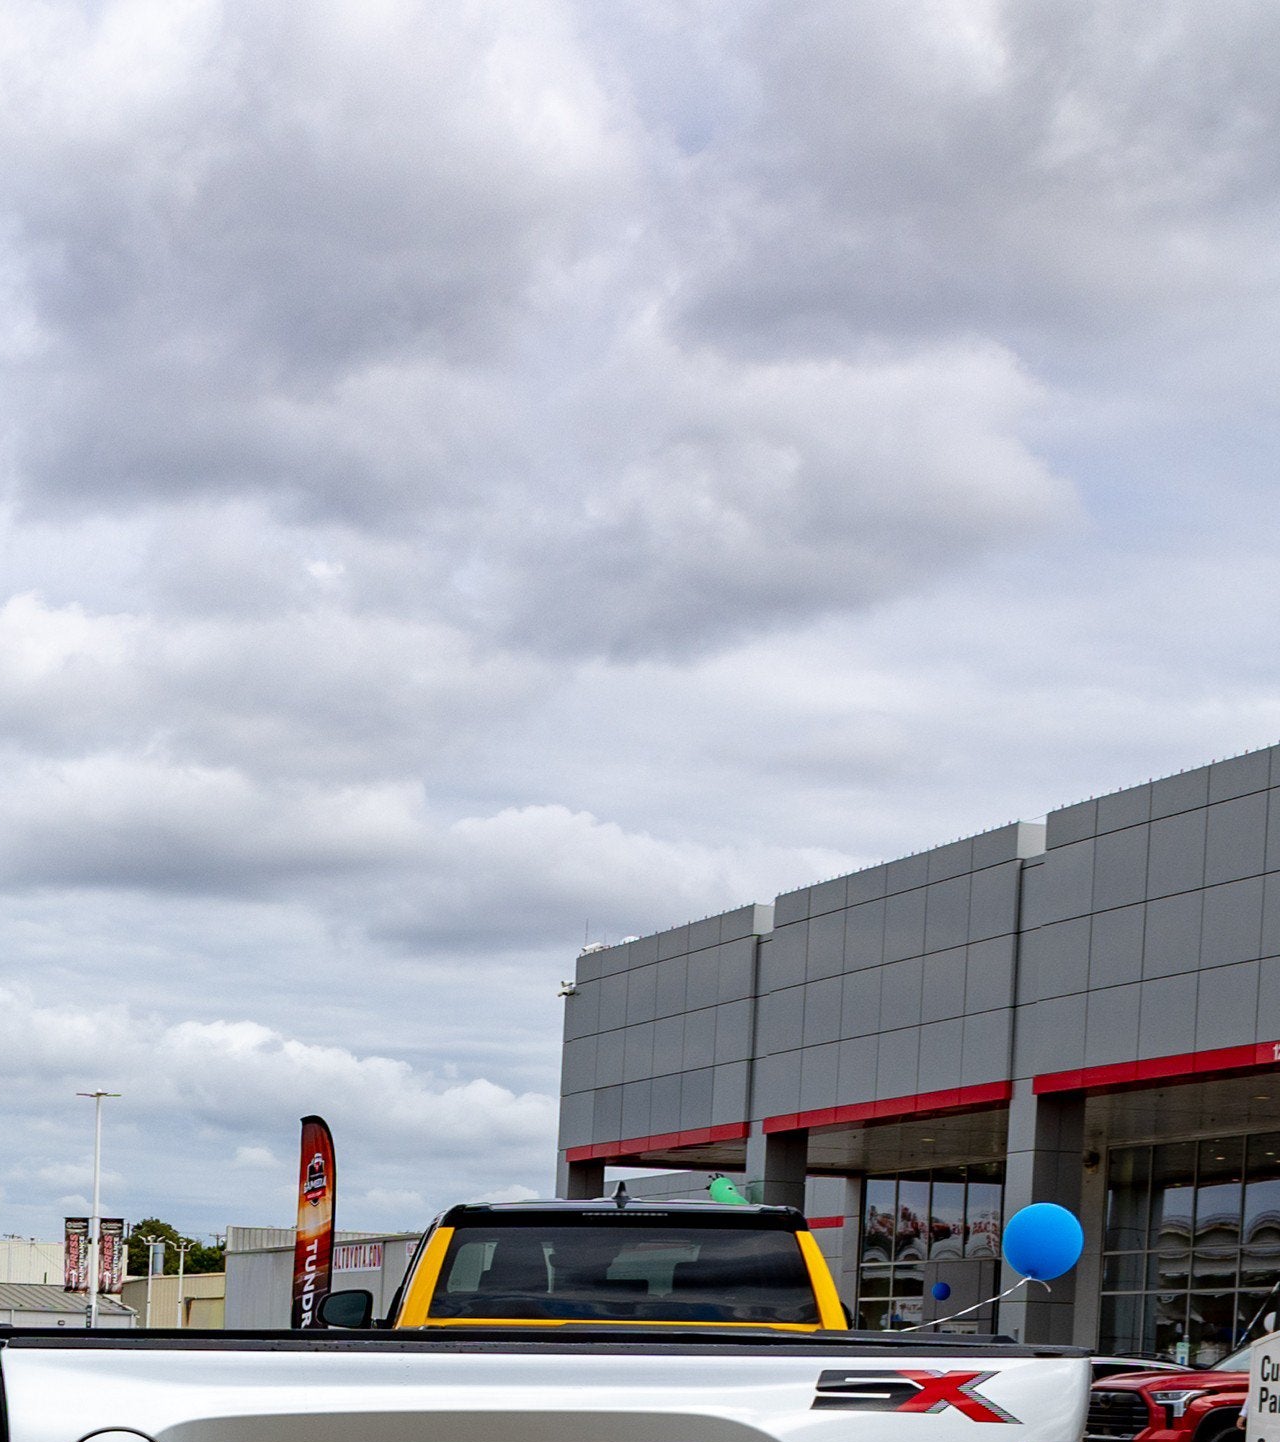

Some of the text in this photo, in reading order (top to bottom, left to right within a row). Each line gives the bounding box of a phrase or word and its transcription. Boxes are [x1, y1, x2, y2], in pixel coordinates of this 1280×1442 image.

[333, 1244, 383, 1270] ALTOYOTA.COM
[301, 1239, 318, 1329] TUNDR
[1260, 1355, 1280, 1382] Cu
